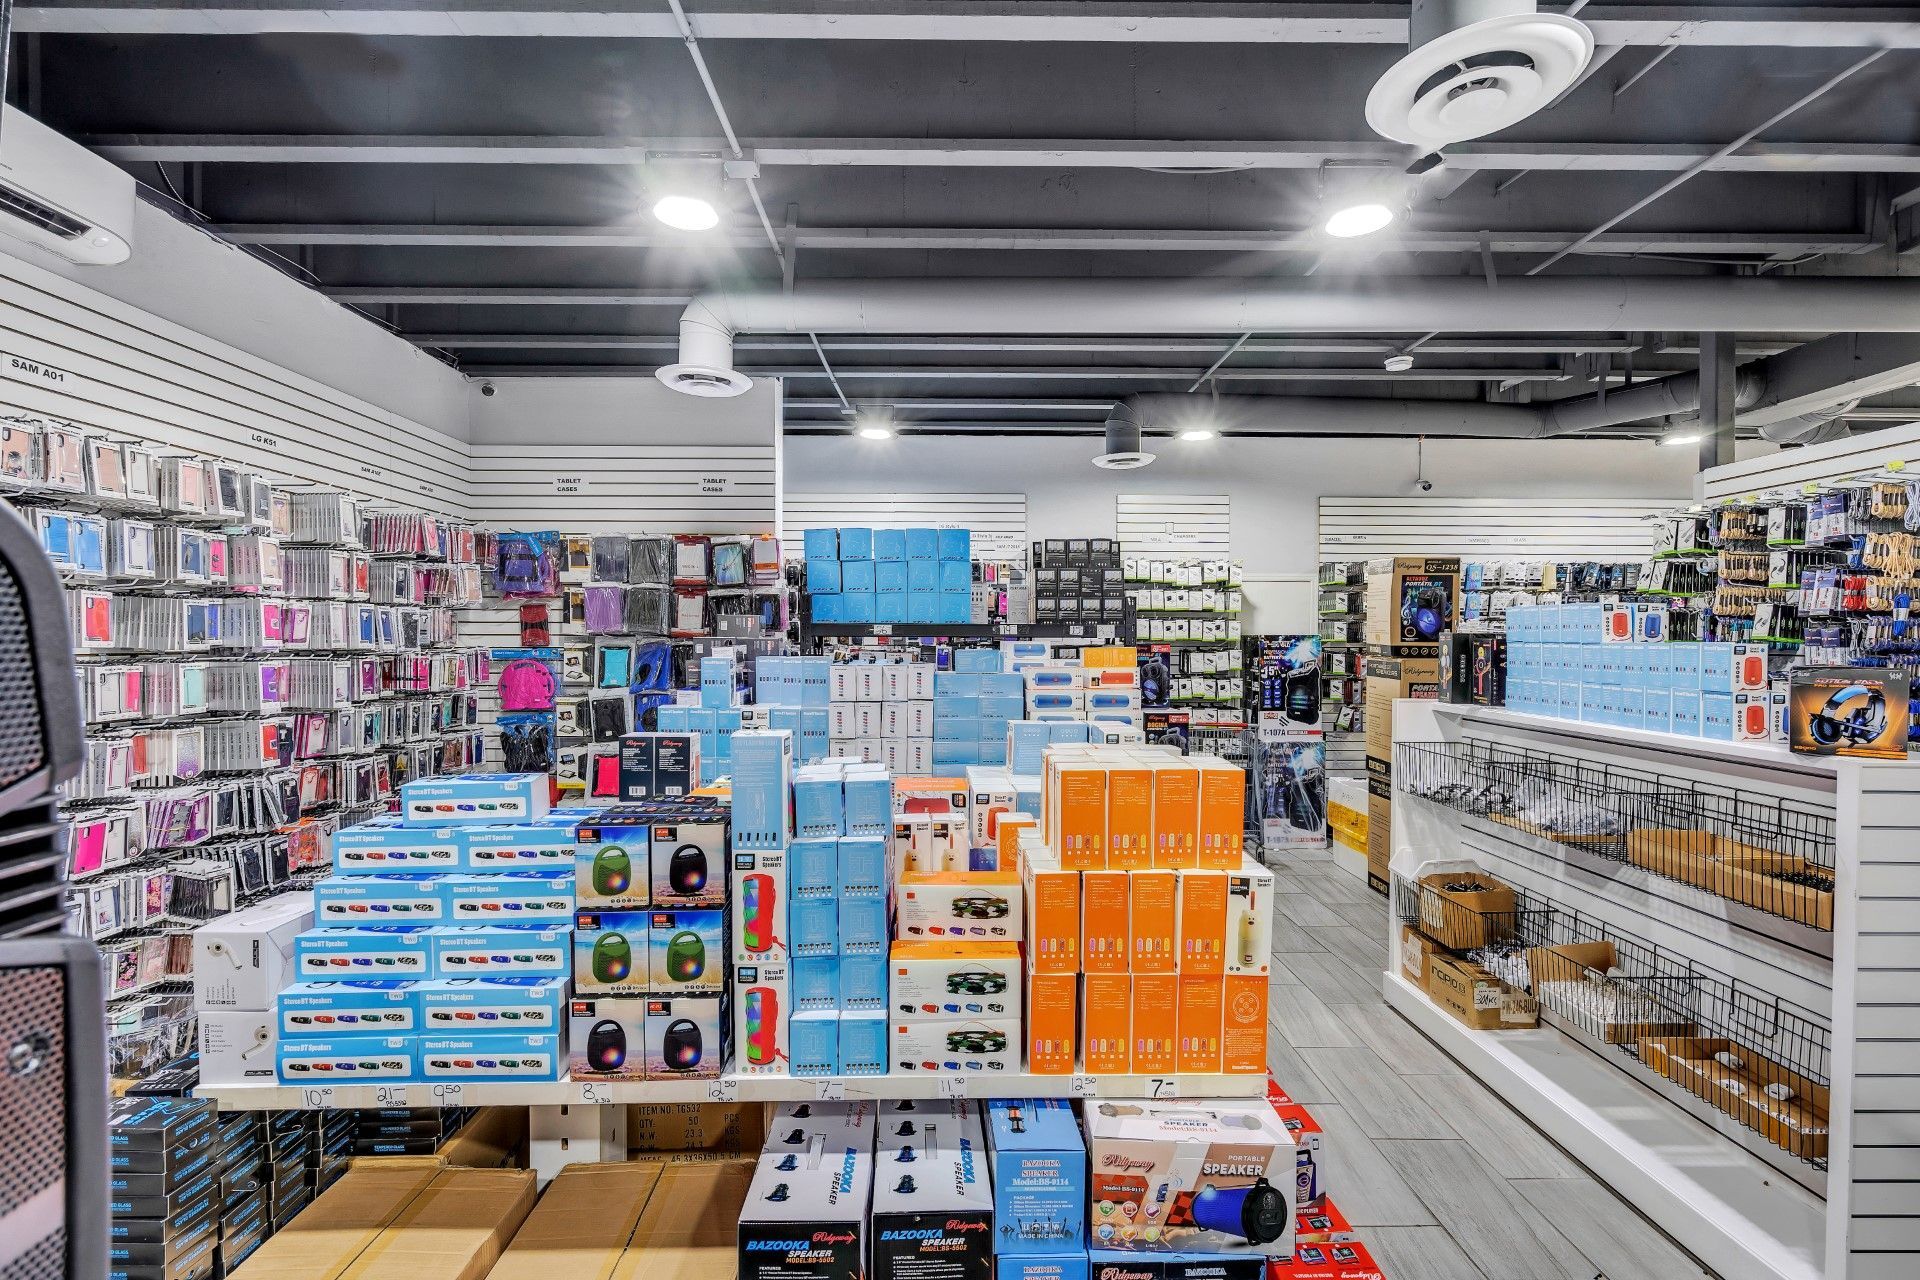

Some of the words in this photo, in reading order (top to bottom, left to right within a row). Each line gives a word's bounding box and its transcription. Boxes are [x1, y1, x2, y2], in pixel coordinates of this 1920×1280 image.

[11, 359, 39, 375] SAM
[43, 369, 64, 382] A01
[252, 434, 262, 443] LG
[264, 438, 277, 448] K51
[638, 1105, 657, 1116] ITEM
[688, 1115, 699, 1126] 50
[724, 1113, 740, 1124] PCS
[1102, 1153, 1155, 1172] Ridgeway
[1203, 1163, 1264, 1176] SPEAKER
[953, 1161, 965, 1196] SPEAKER
[828, 1171, 842, 1205] SPEAKER
[945, 1220, 986, 1233] Ridgeway
[811, 1231, 855, 1245] Ridgeway
[880, 1229, 943, 1240] BAZOOKA
[746, 1240, 810, 1251] BAZOOKA
[921, 1238, 966, 1246] SPEAKER
[788, 1249, 832, 1258] SPEAKER
